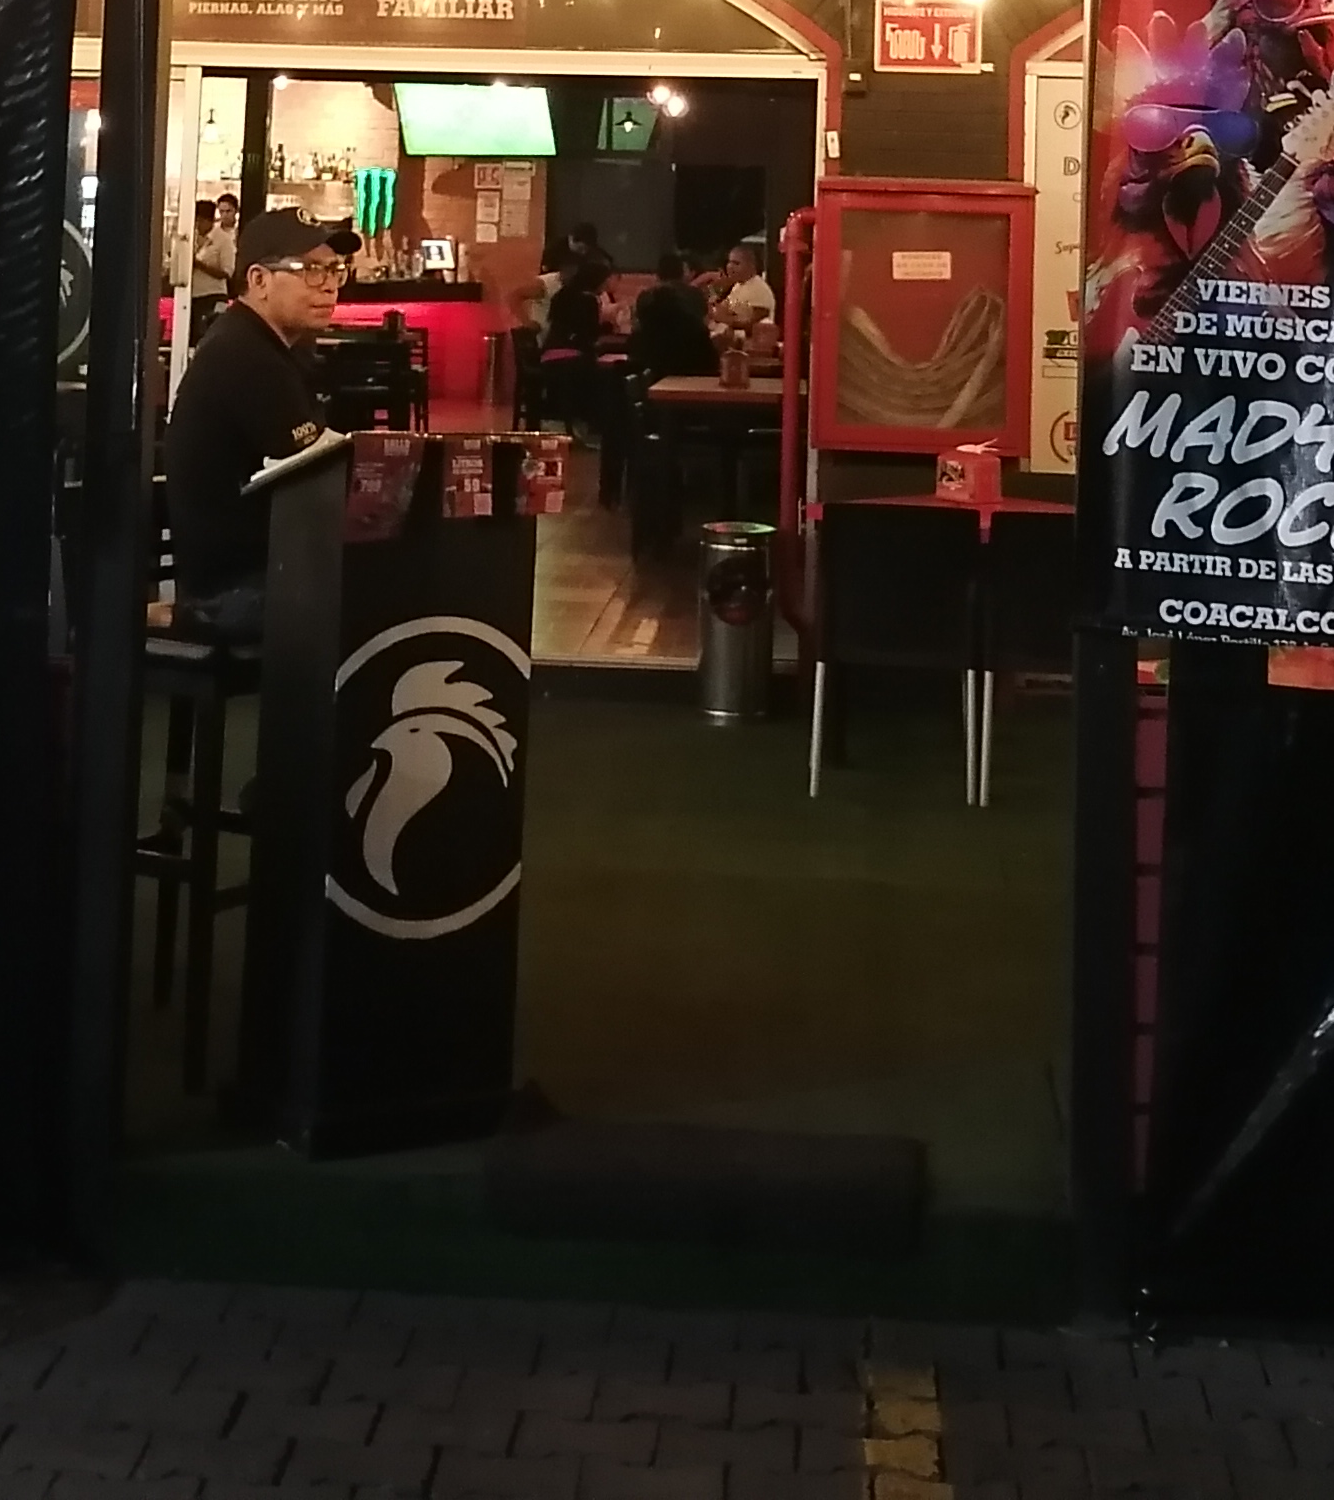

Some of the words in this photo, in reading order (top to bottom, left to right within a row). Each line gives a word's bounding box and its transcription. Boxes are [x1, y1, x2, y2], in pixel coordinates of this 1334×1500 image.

[1196, 278, 1331, 309] VIERNES
[1174, 311, 1217, 336] DE
[1130, 344, 1185, 374] EN
[1193, 348, 1286, 380] VIVO
[1114, 548, 1133, 569] A
[1138, 550, 1232, 577] PARTIR
[1238, 558, 1276, 580] DE
[1282, 561, 1334, 586] LAS
